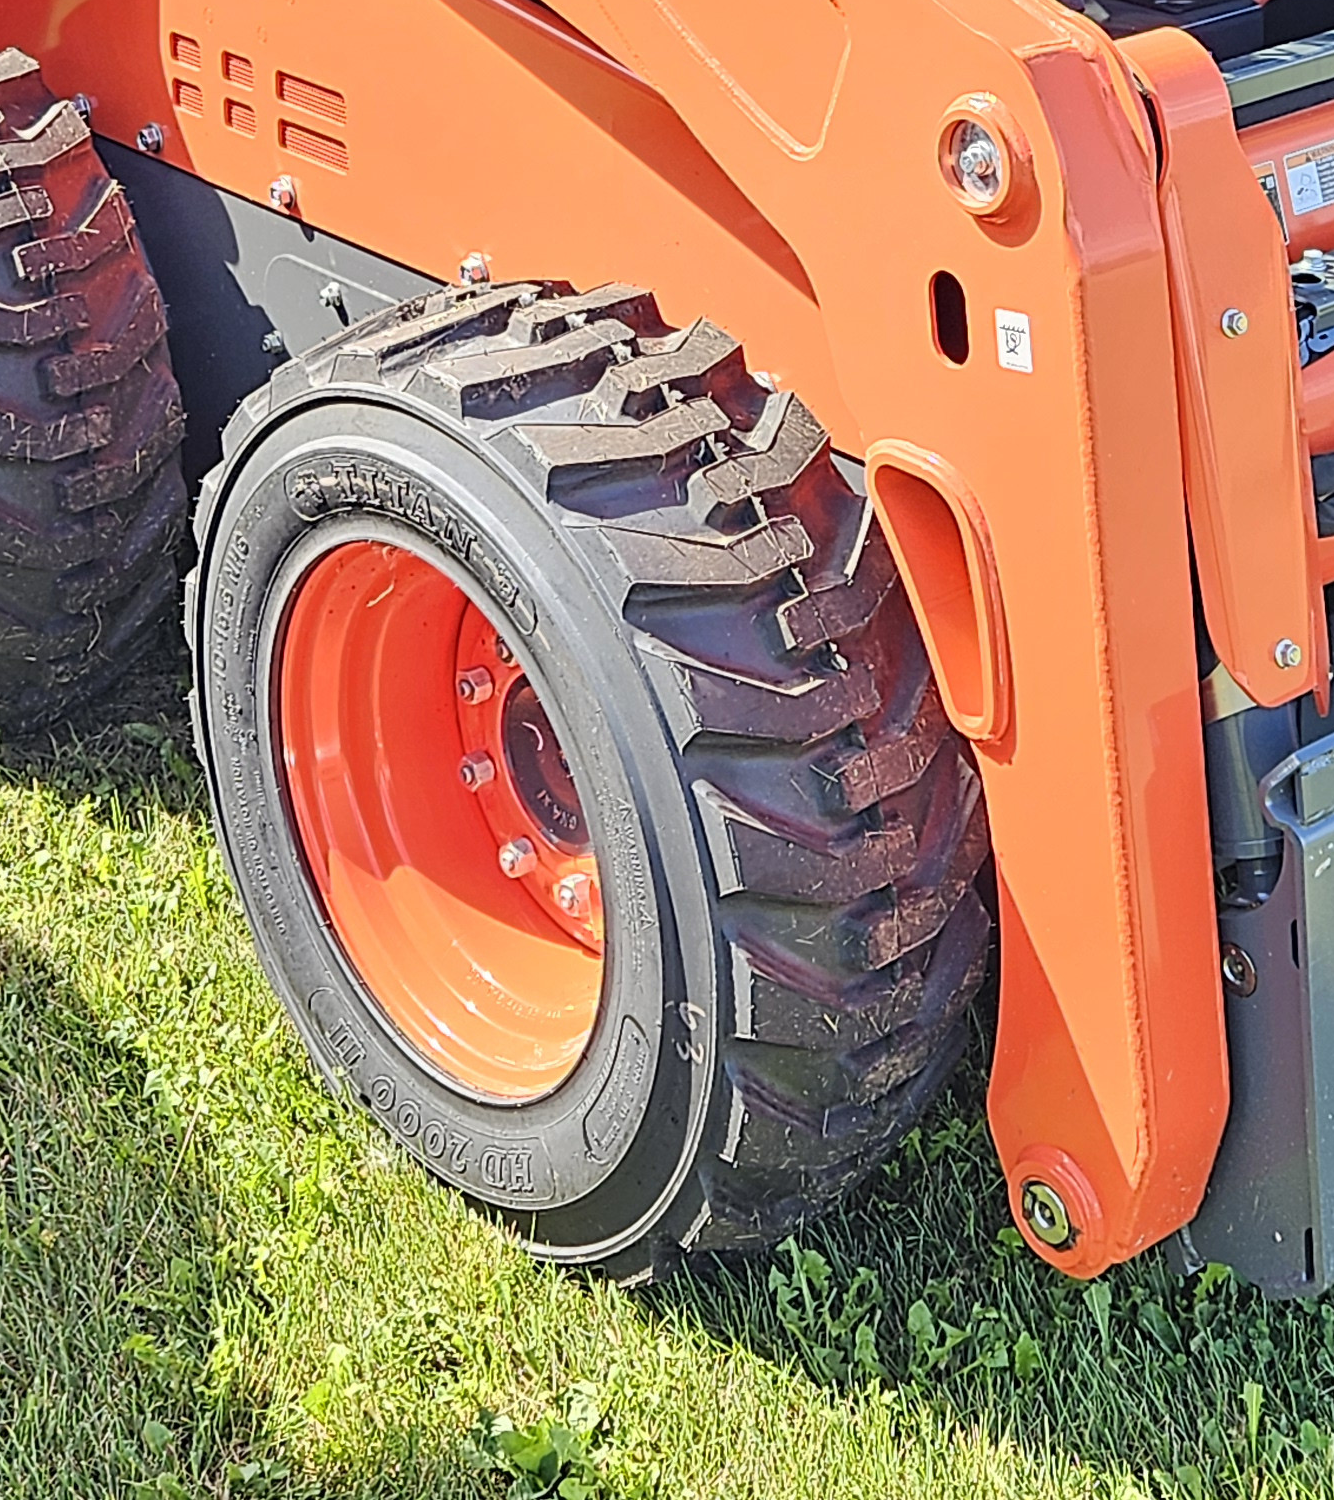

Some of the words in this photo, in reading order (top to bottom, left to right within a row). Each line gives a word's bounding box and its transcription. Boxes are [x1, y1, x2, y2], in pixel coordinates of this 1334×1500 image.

[330, 459, 478, 561] TITAN
[370, 1075, 473, 1174] 2000
[480, 1144, 535, 1194] HD
